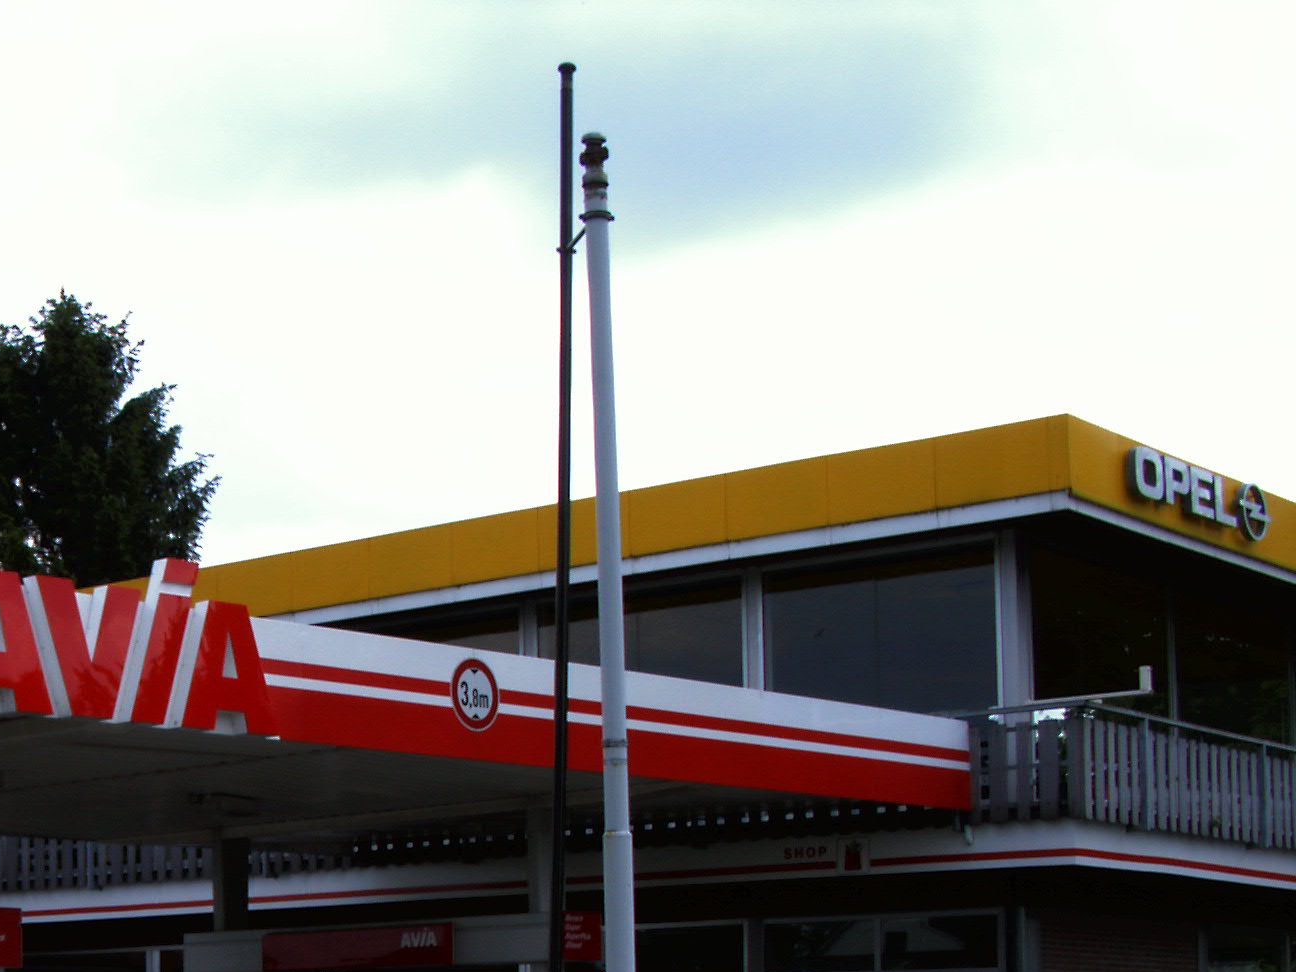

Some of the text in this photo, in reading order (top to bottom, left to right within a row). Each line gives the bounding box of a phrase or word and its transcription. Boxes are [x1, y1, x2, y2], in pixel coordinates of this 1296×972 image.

[1126, 446, 1238, 528] OPEL
[460, 680, 490, 709] 3,8m
[784, 846, 827, 860] SHOP
